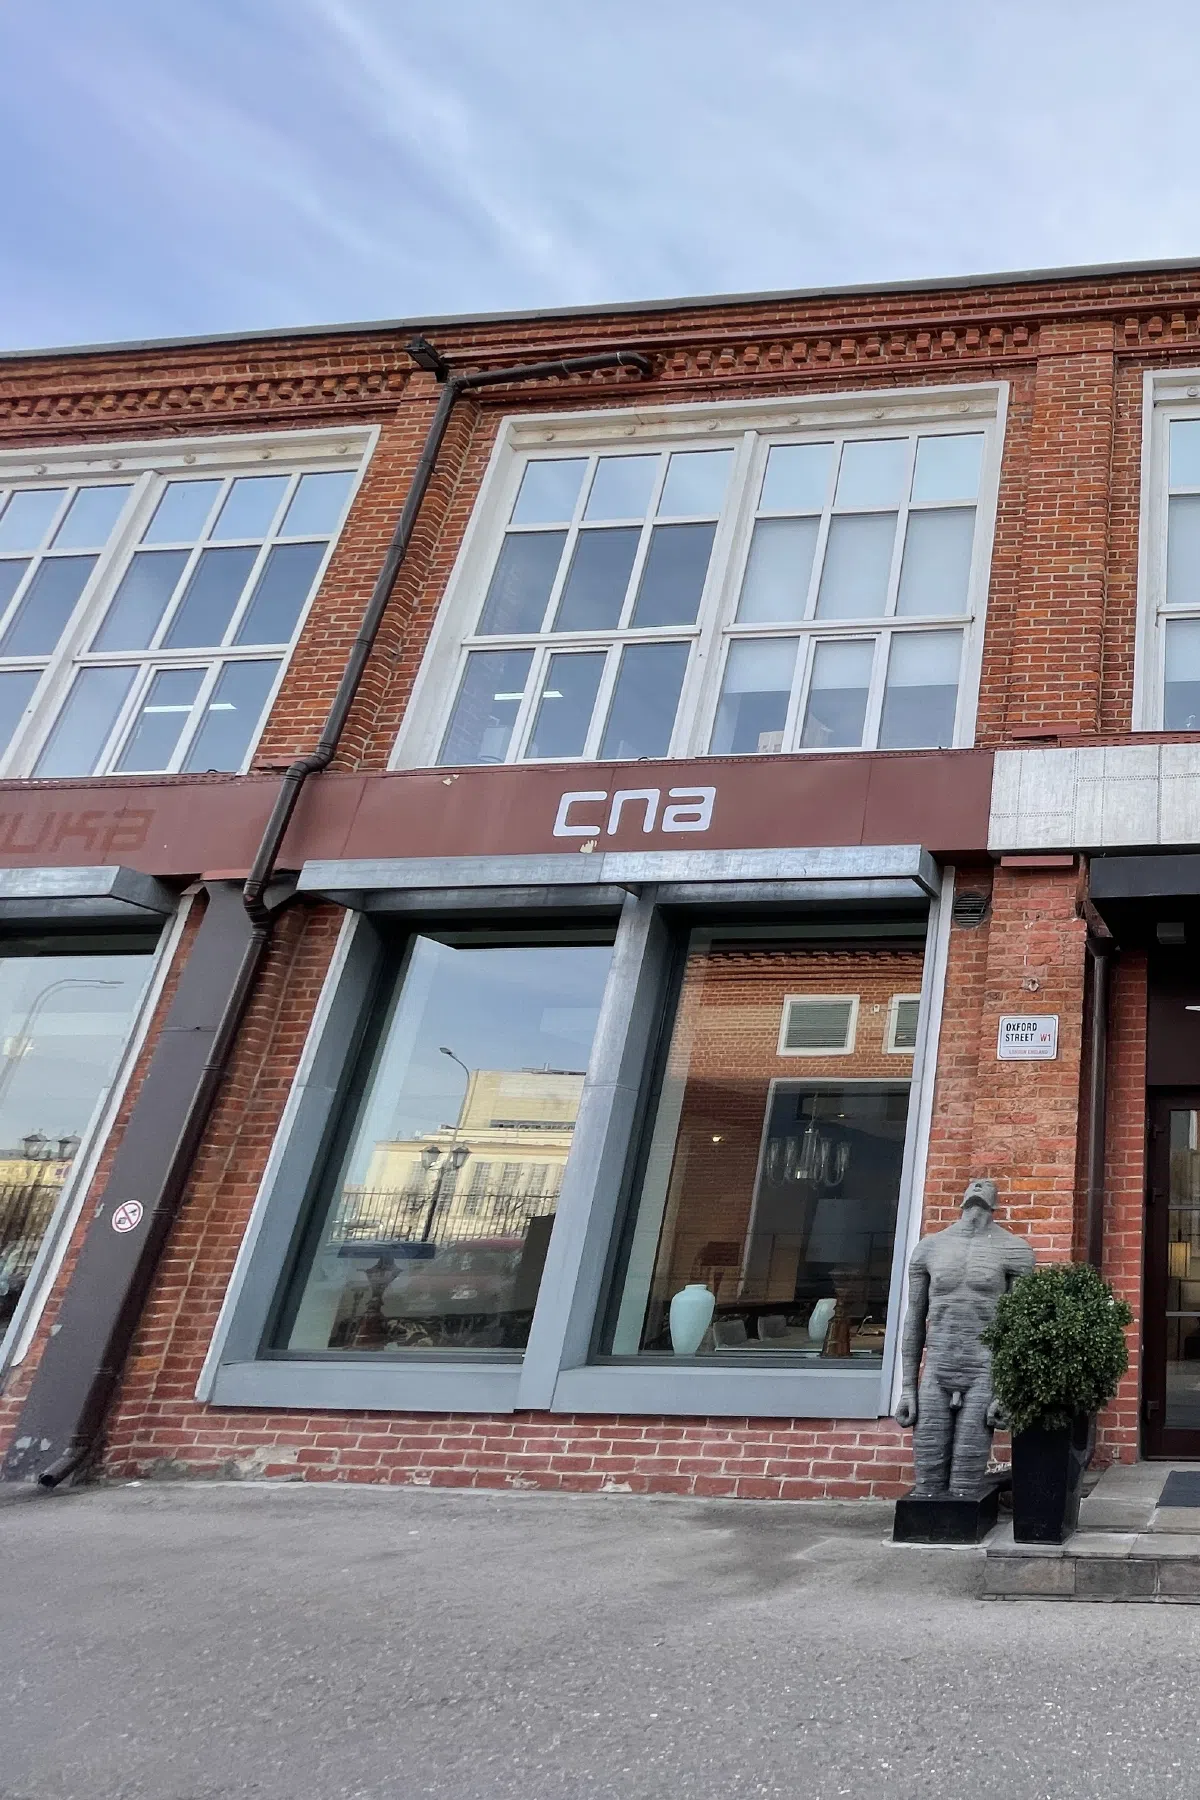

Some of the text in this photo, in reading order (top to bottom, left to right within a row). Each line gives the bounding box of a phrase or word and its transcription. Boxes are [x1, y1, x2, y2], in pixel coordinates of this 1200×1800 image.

[0, 809, 156, 853] ика
[1006, 1022, 1038, 1032] OXFORD
[1005, 1033, 1051, 1042] STREET W1
